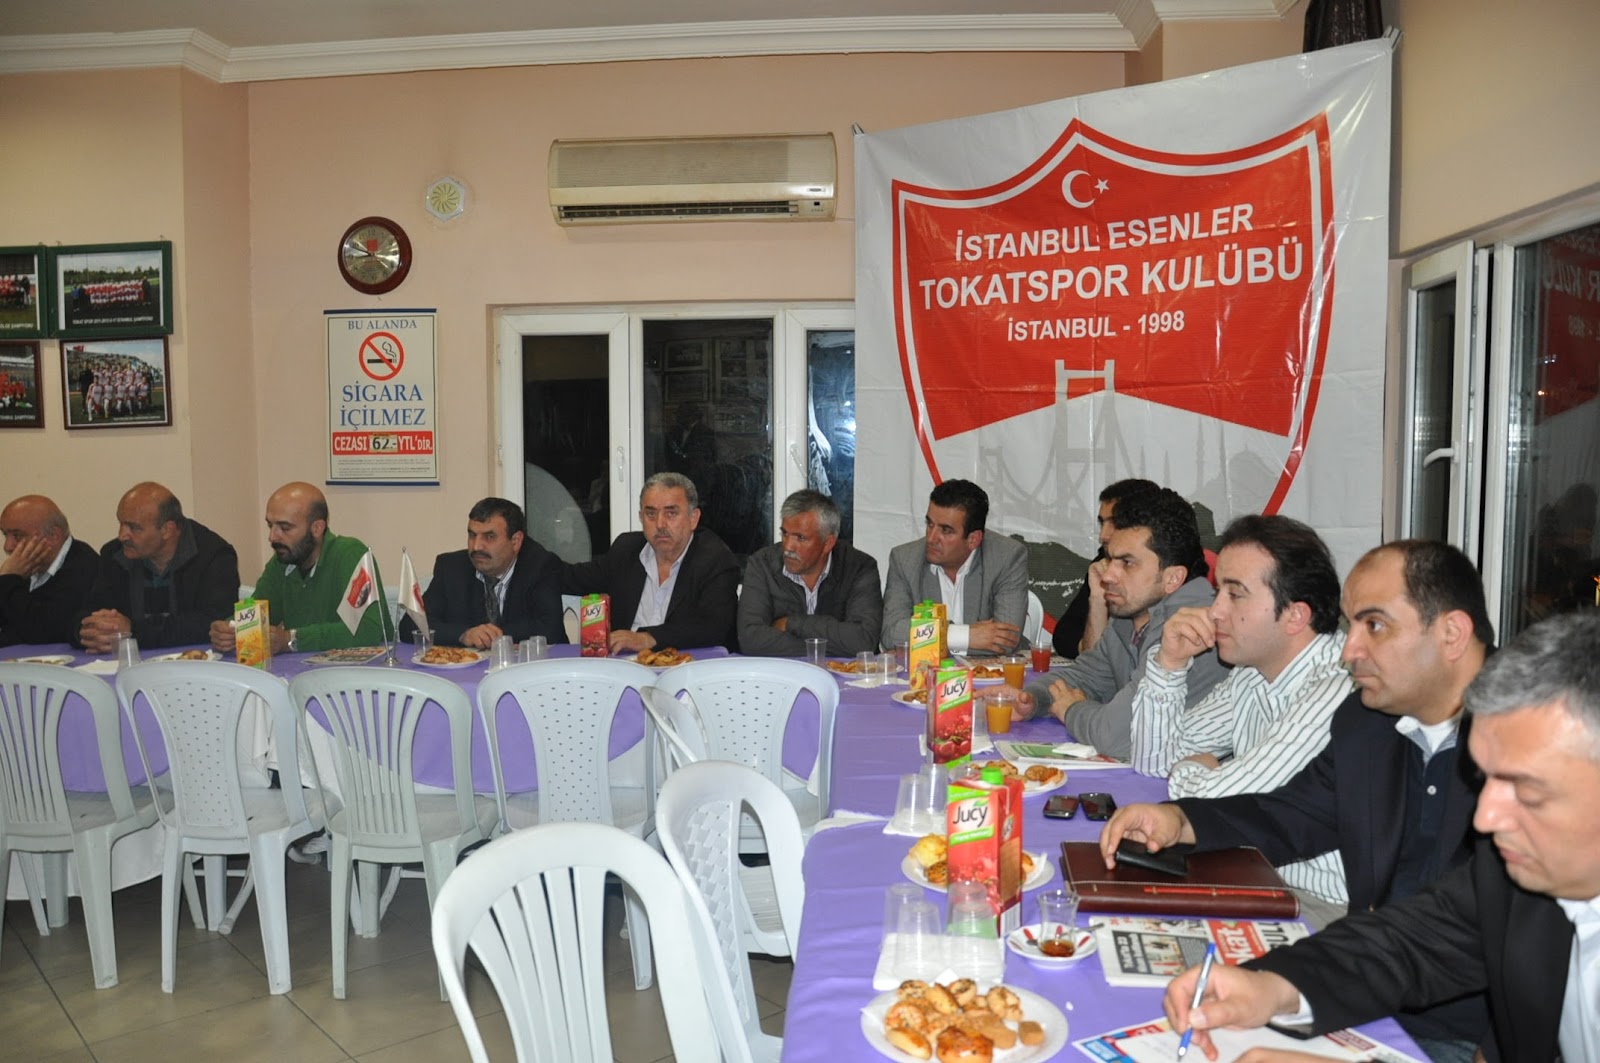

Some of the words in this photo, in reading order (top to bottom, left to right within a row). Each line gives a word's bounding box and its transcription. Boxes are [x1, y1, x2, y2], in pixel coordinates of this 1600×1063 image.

[955, 224, 1100, 261] İSTANBUL
[1108, 203, 1254, 250] ESENLER
[919, 264, 1129, 310] TOKATSPOR
[1141, 236, 1303, 295] KULÜBÜ
[348, 321, 363, 330] BU
[367, 319, 417, 330] ALANDA
[1007, 315, 1116, 342] İSTANBUL
[1137, 310, 1185, 335] 1998
[342, 381, 423, 403] SİGARA
[340, 405, 426, 431] İÇİLMEZ
[334, 436, 367, 451] CEZASI
[237, 610, 256, 622] Jucy
[583, 606, 601, 617] Jucy
[914, 626, 935, 639] Jucy
[940, 680, 967, 697] Jucy
[952, 805, 988, 828] Jucy
[1217, 928, 1256, 964] kat
